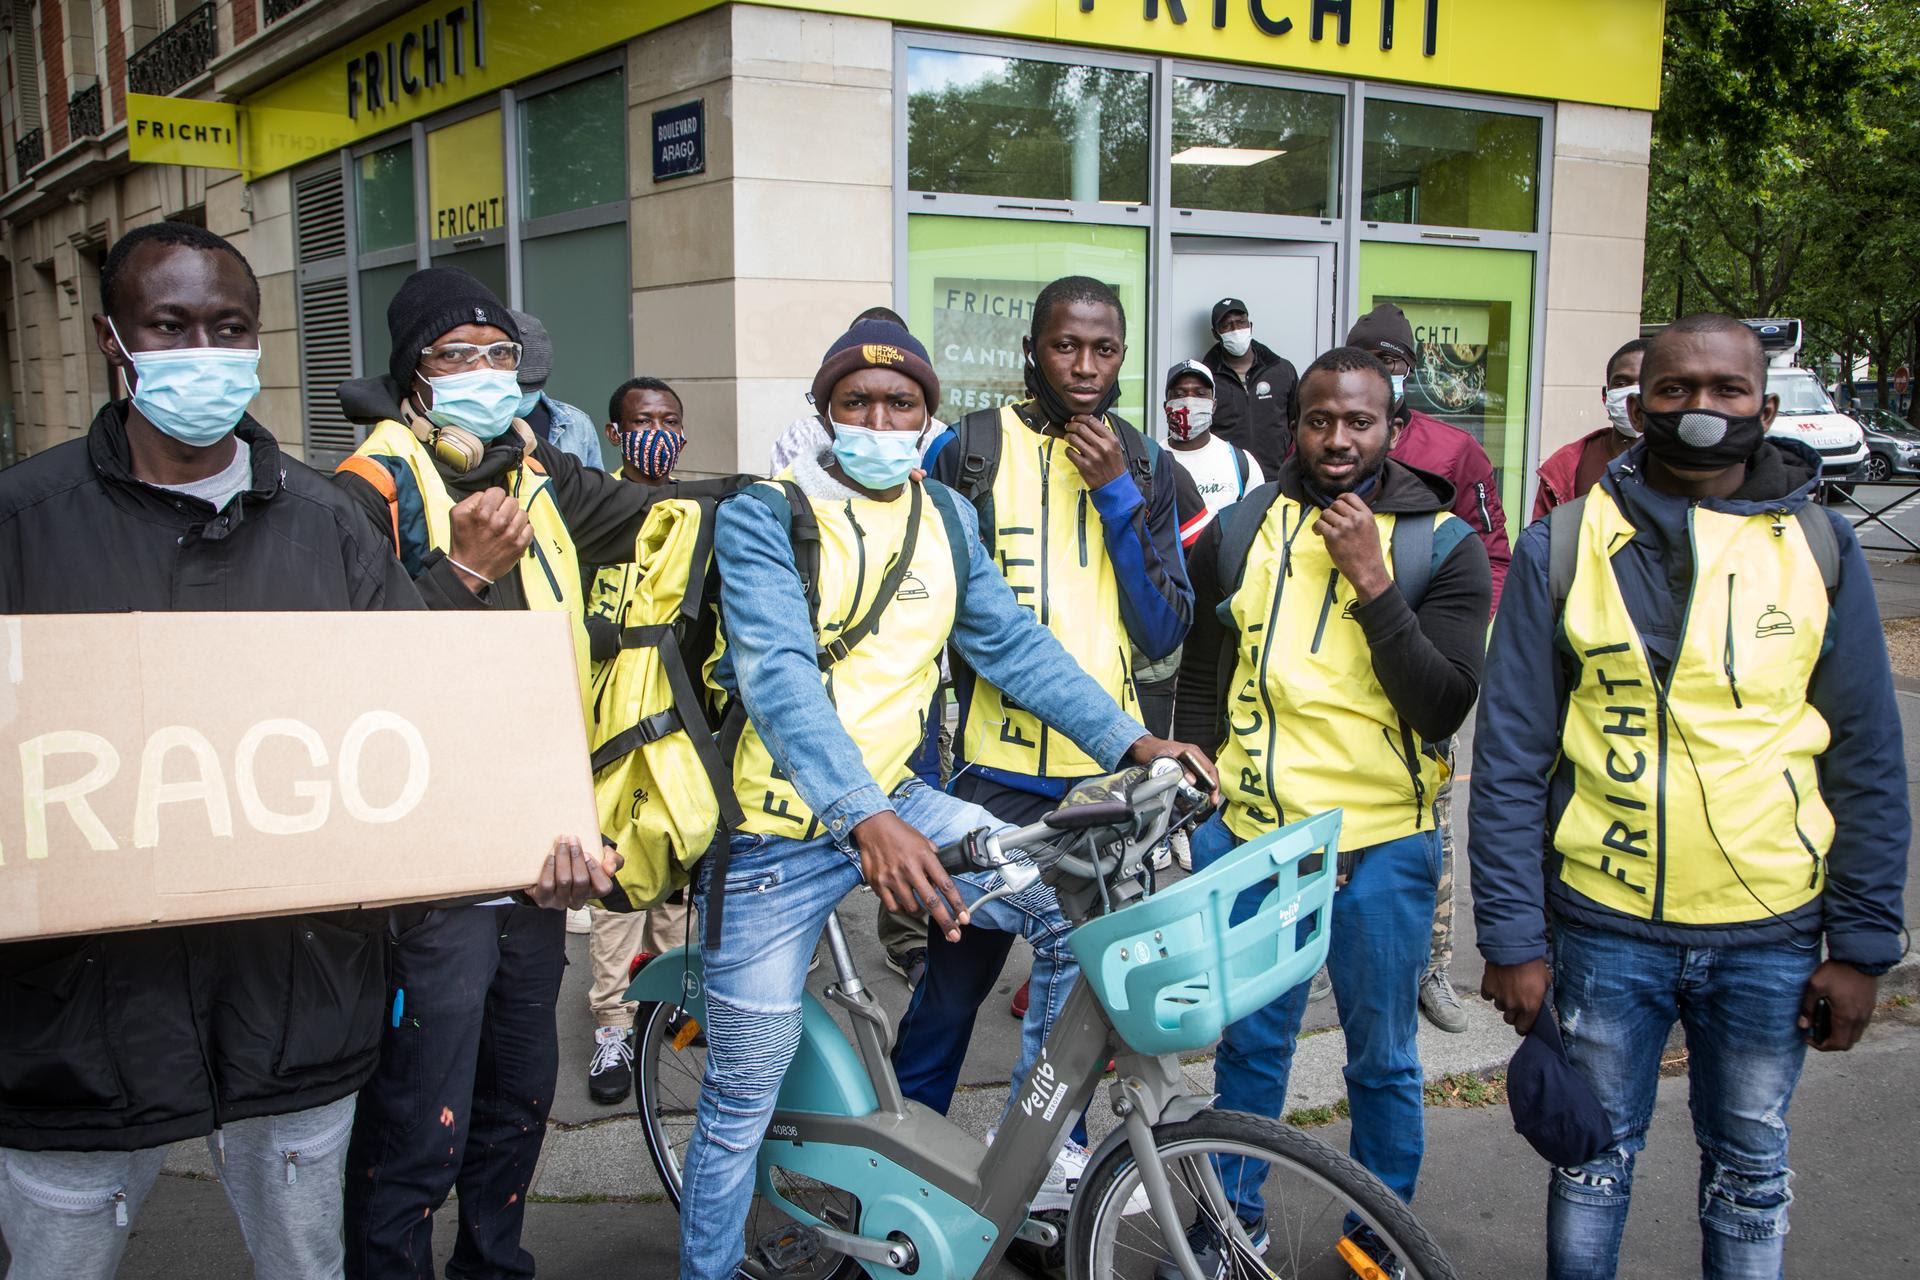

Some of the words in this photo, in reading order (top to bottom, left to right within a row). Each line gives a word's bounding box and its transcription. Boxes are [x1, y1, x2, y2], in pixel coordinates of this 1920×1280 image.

[347, 0, 486, 119] FRICHTI
[136, 119, 231, 145] FRICHTI
[658, 116, 698, 142] BOULEVARD
[661, 140, 695, 162] ARAGO
[1584, 642, 1648, 895] FRICHTI
[0, 710, 430, 866] RAGO
[772, 1124, 798, 1136] 40836
